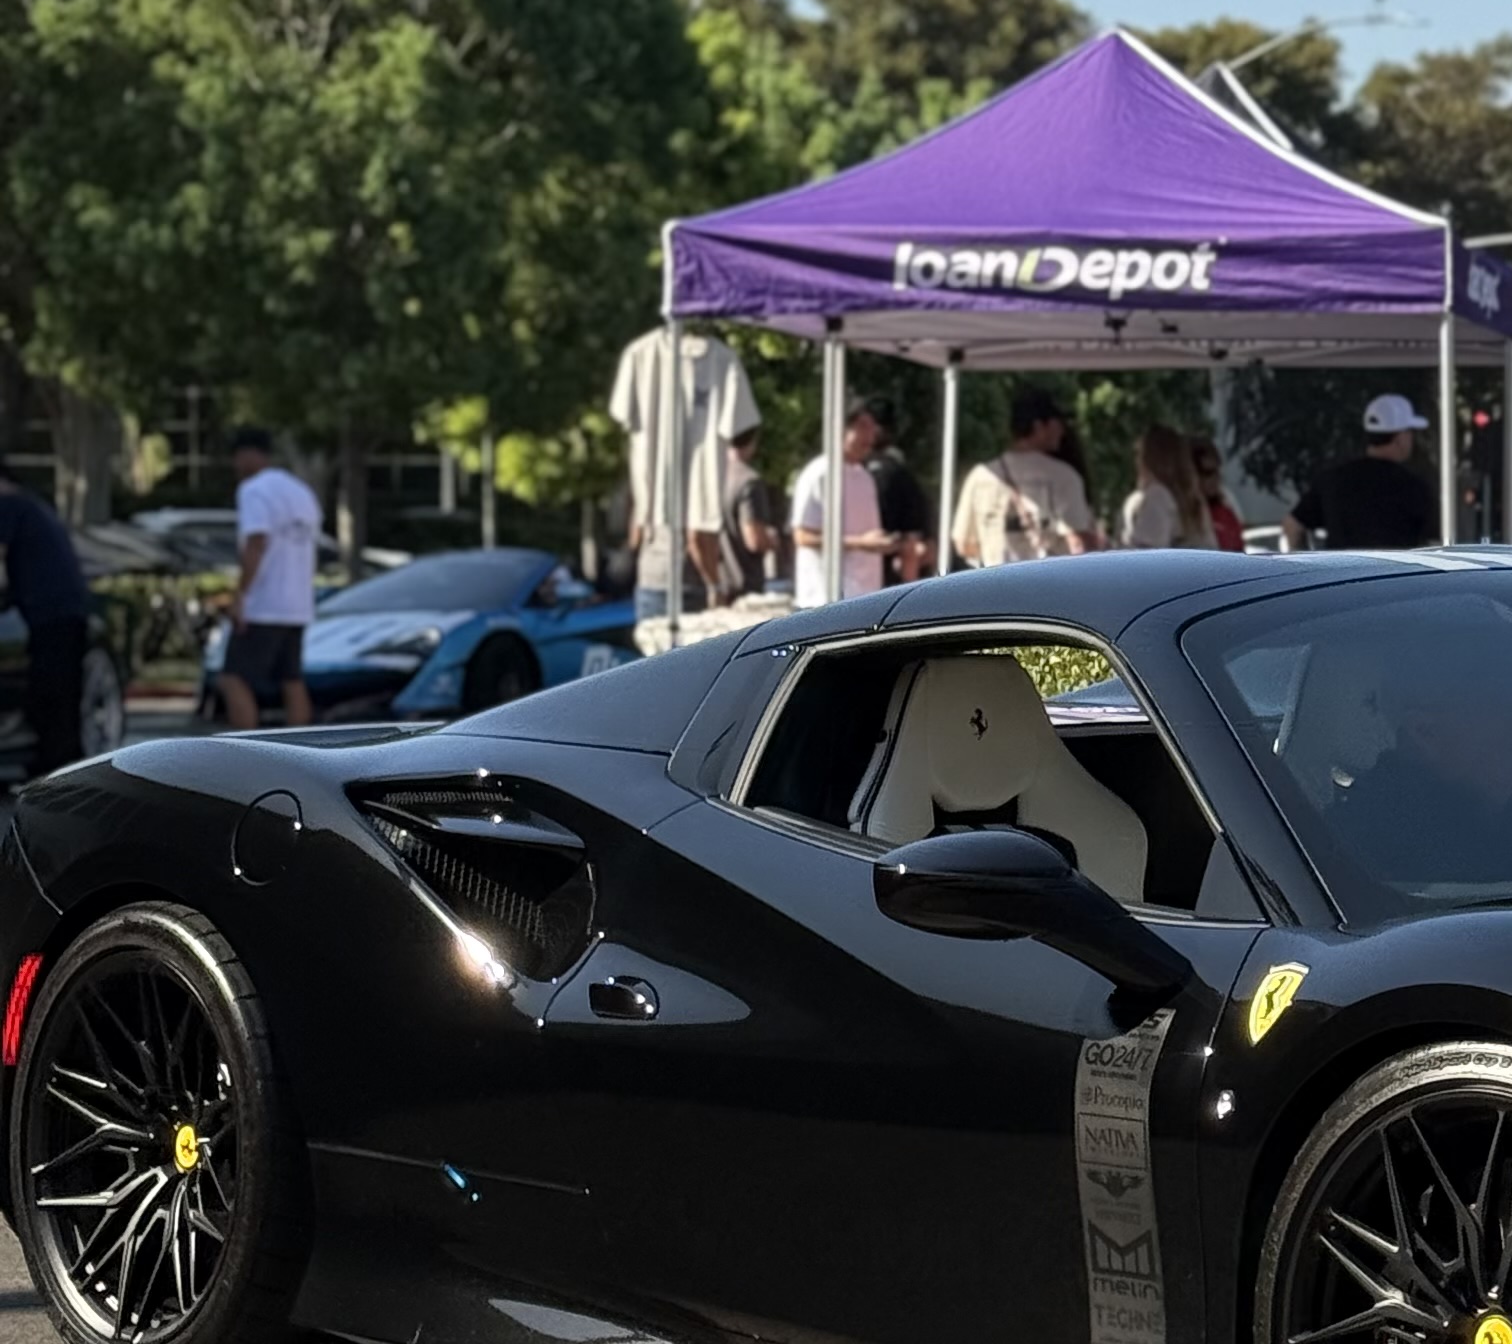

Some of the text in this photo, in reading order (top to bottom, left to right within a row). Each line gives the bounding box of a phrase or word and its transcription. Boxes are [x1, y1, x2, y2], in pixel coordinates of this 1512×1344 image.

[893, 242, 1217, 301] loanDepot
[1085, 1042, 1154, 1072] GO24/7
[1093, 1277, 1160, 1301] melin
